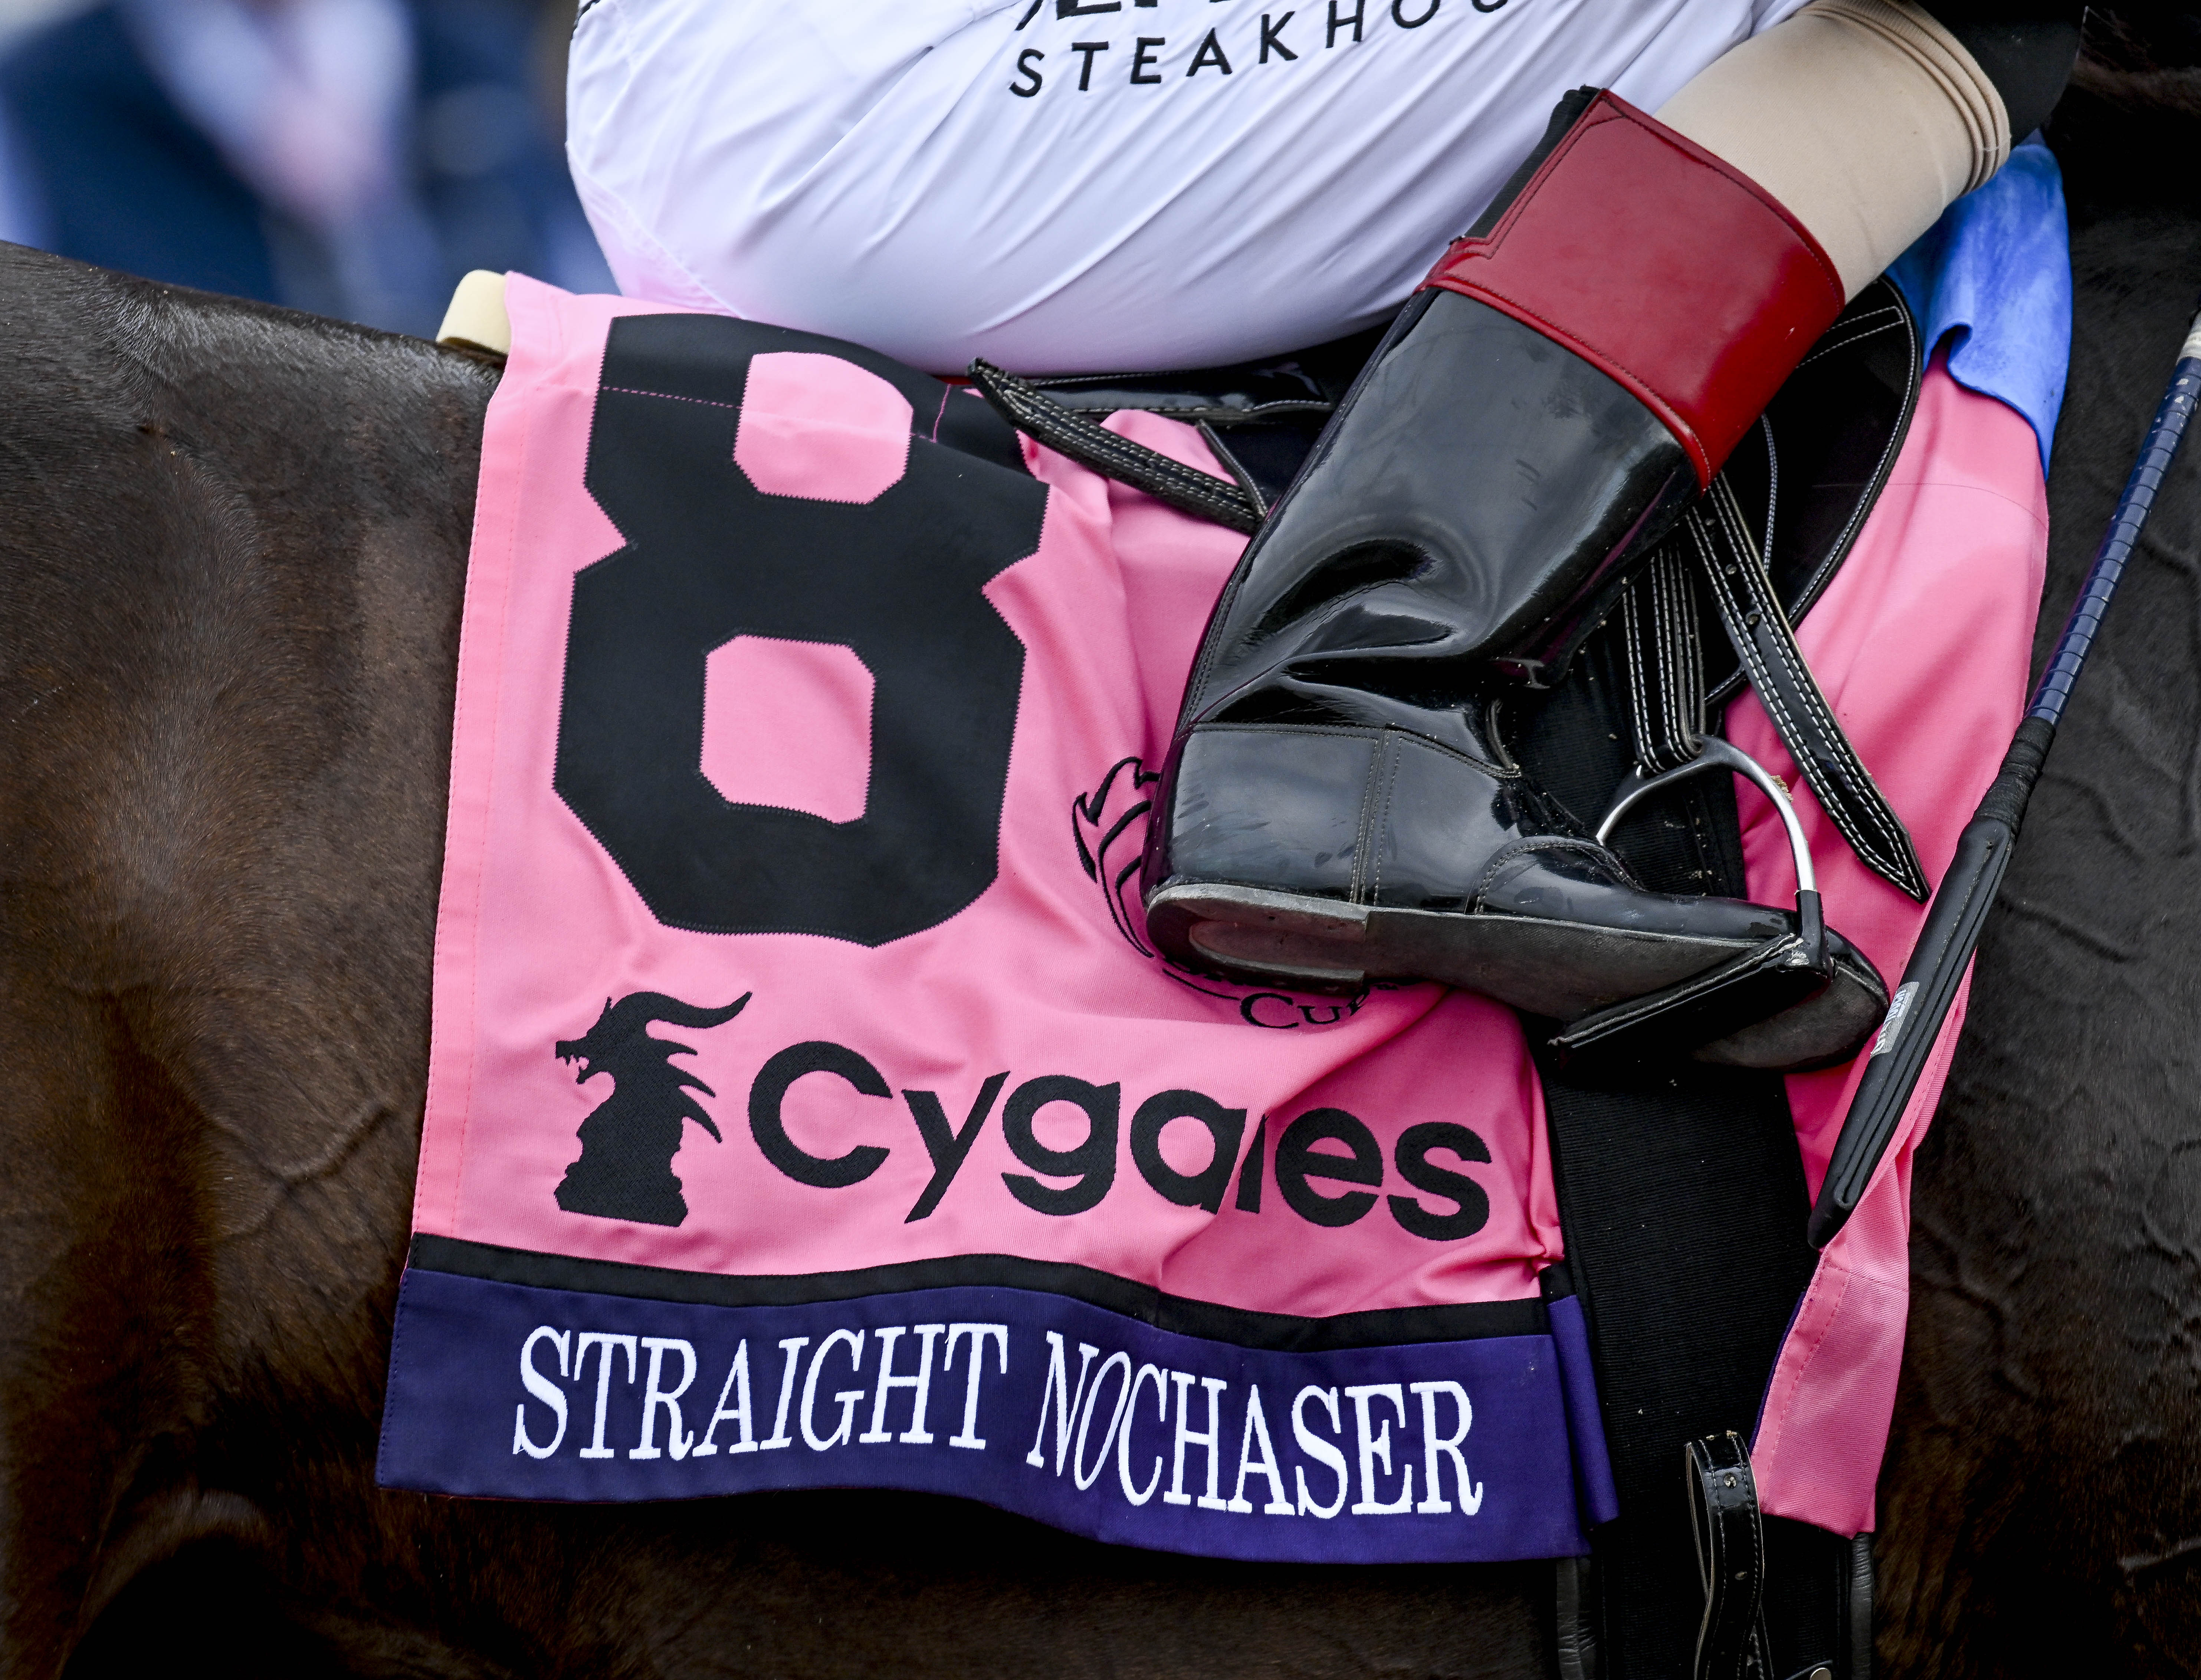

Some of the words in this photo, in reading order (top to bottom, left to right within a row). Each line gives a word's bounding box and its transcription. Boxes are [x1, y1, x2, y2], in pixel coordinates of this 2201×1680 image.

[1009, 0, 1509, 98] STEAKHO
[553, 313, 1050, 948] 8
[512, 1322, 1009, 1462] STRAIGHT
